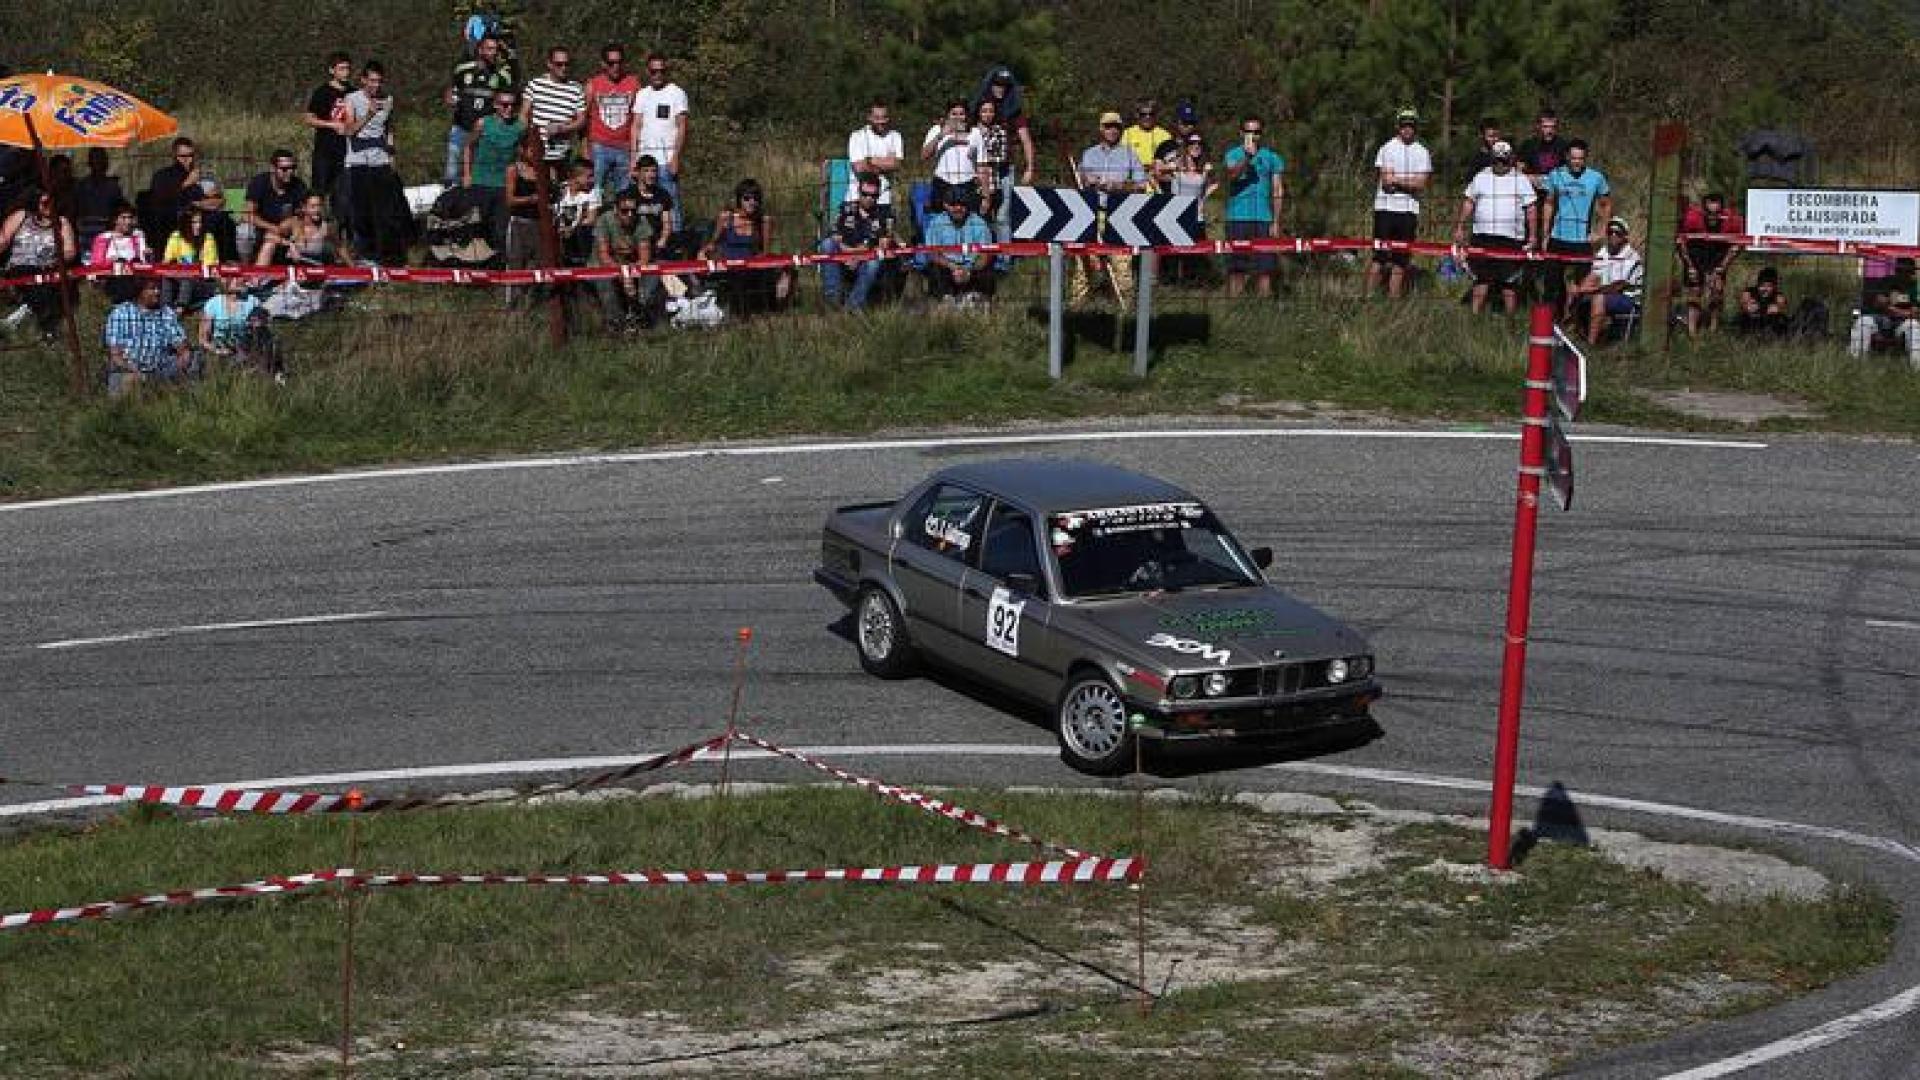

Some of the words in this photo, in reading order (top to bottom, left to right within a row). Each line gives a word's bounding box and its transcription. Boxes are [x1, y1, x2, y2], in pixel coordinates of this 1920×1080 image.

[1787, 193, 1879, 207] ESCOMBRERA
[1787, 210, 1879, 223] CLAUSURADA
[1764, 223, 1813, 235] Prohibido
[993, 605, 1017, 644] 92
